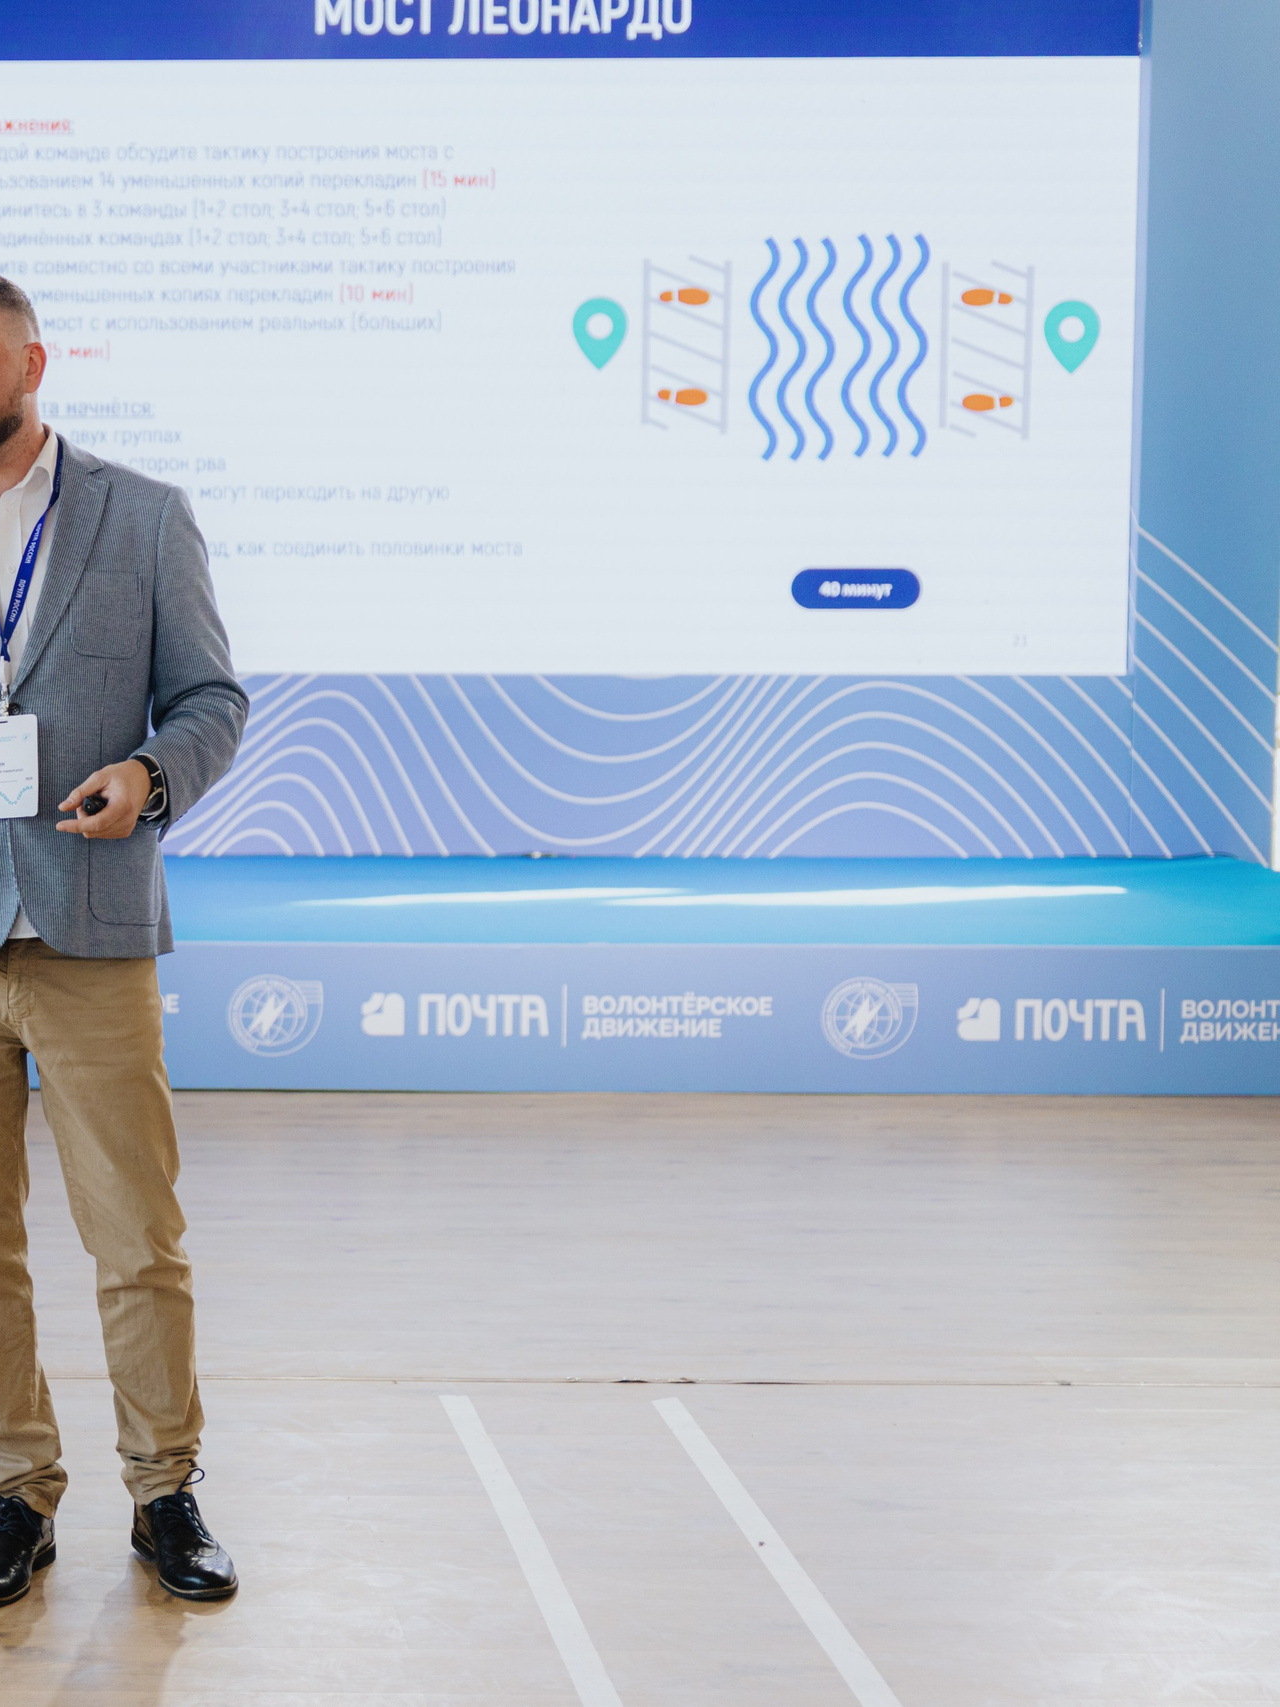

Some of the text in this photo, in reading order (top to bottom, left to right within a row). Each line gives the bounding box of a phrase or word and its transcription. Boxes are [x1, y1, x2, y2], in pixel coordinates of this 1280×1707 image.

[314, 0, 693, 41] МОСТ ЛЕОНАРДО
[35, 147, 110, 163] команде
[117, 142, 197, 164] обсудите
[204, 146, 270, 163] тактику
[277, 146, 379, 163] построения
[386, 146, 437, 160] моста
[444, 145, 454, 160] с
[100, 171, 115, 187] 14
[121, 174, 245, 191] уменьшенных
[252, 170, 304, 188] копий
[311, 174, 416, 191] перекладин
[78, 204, 86, 218] в
[93, 199, 102, 218] 3
[108, 204, 186, 219] команды
[98, 232, 183, 248] командах
[33, 261, 127, 275] совместно
[134, 261, 154, 275] со
[160, 261, 213, 274] всеми
[220, 261, 333, 277] участниками
[340, 260, 406, 277] тактику
[413, 260, 515, 277] построения
[30, 290, 154, 308] уменьшенных
[161, 289, 221, 303] копиях
[228, 288, 333, 305] перекладин
[43, 317, 82, 331] мост
[90, 318, 98, 331] с
[106, 317, 253, 331] использованием
[259, 317, 344, 335] реальных
[69, 431, 181, 447] двух группах
[129, 458, 226, 475] сторон рва
[199, 486, 246, 503] могут
[254, 487, 355, 502] переходить
[362, 487, 381, 499] на
[387, 486, 449, 504] другую
[236, 542, 265, 556] как
[273, 542, 364, 558] соединить
[371, 542, 464, 556] половинки
[471, 542, 522, 556] моста
[8, 578, 27, 623] ПОЧТА РОССИИ
[818, 580, 893, 601] 40 минут
[418, 990, 773, 1036] ПОЧТА ВОЛОНТЁРСКОЕ
[1014, 998, 1280, 1042] ПОЧТА ВОЛОНТ
[581, 1017, 723, 1040] ДВИЖЕНИЕ
